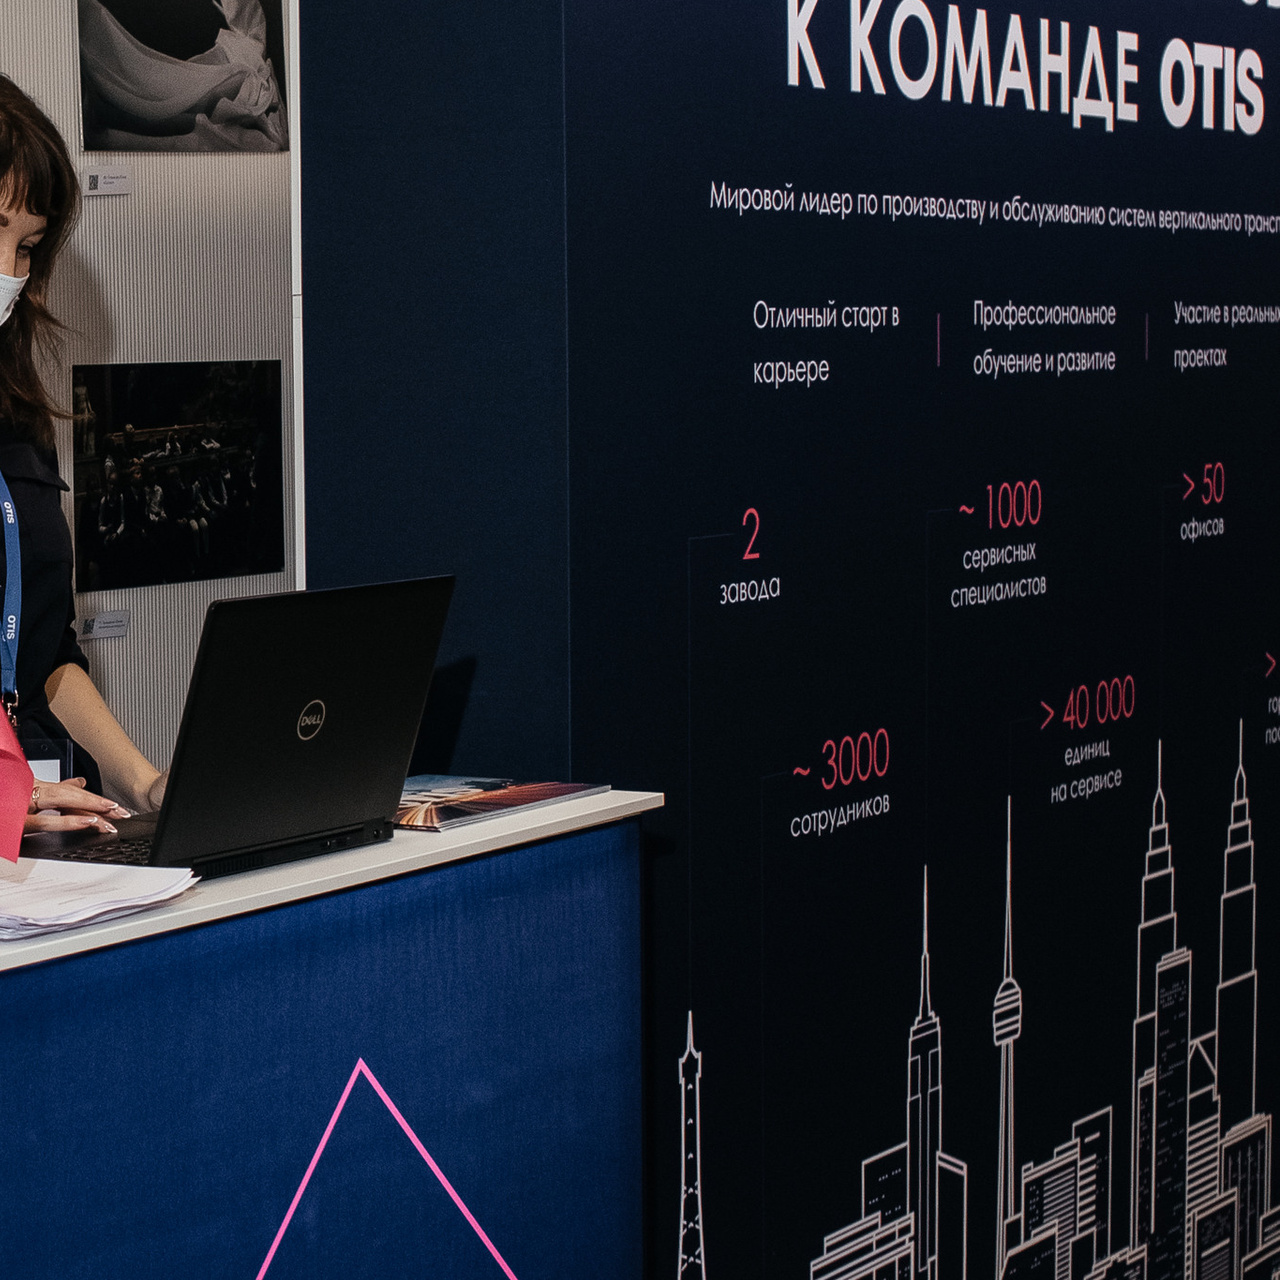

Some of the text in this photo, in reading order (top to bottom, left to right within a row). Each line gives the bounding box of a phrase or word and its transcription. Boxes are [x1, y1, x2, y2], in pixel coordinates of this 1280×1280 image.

[1159, 37, 1266, 136] OTIS
[709, 180, 795, 216] Мировой
[799, 191, 853, 220] лидер
[857, 193, 878, 216] по
[882, 194, 987, 226] производству
[989, 200, 999, 220] и
[1002, 195, 1106, 228] обслуживанию
[1108, 207, 1157, 229] систем
[1158, 209, 1242, 235] вертикального
[753, 299, 900, 334] Отличный старт в
[973, 299, 1117, 331] Профессиональное
[1174, 300, 1222, 325] Участие
[1223, 305, 1230, 324] в
[753, 359, 830, 390] карьере
[973, 348, 1116, 380] обучение и развитие
[1174, 348, 1227, 373] проектах
[1201, 462, 1225, 505] 50
[3, 501, 15, 524] OTIS
[986, 479, 1042, 530] 1000
[742, 507, 760, 560] 2
[1180, 516, 1225, 544] офисов
[962, 542, 1037, 573] сервисных
[719, 577, 781, 605] завода
[950, 575, 1047, 608] специалистов
[6, 614, 17, 640] OTIS
[1062, 684, 1090, 730] 40
[1096, 674, 1135, 724] 000
[301, 714, 321, 727] DELL
[821, 727, 890, 790] 3000
[1064, 738, 1111, 767] единиц
[1050, 768, 1123, 804] на сервисе
[790, 794, 890, 837] сотрудников
